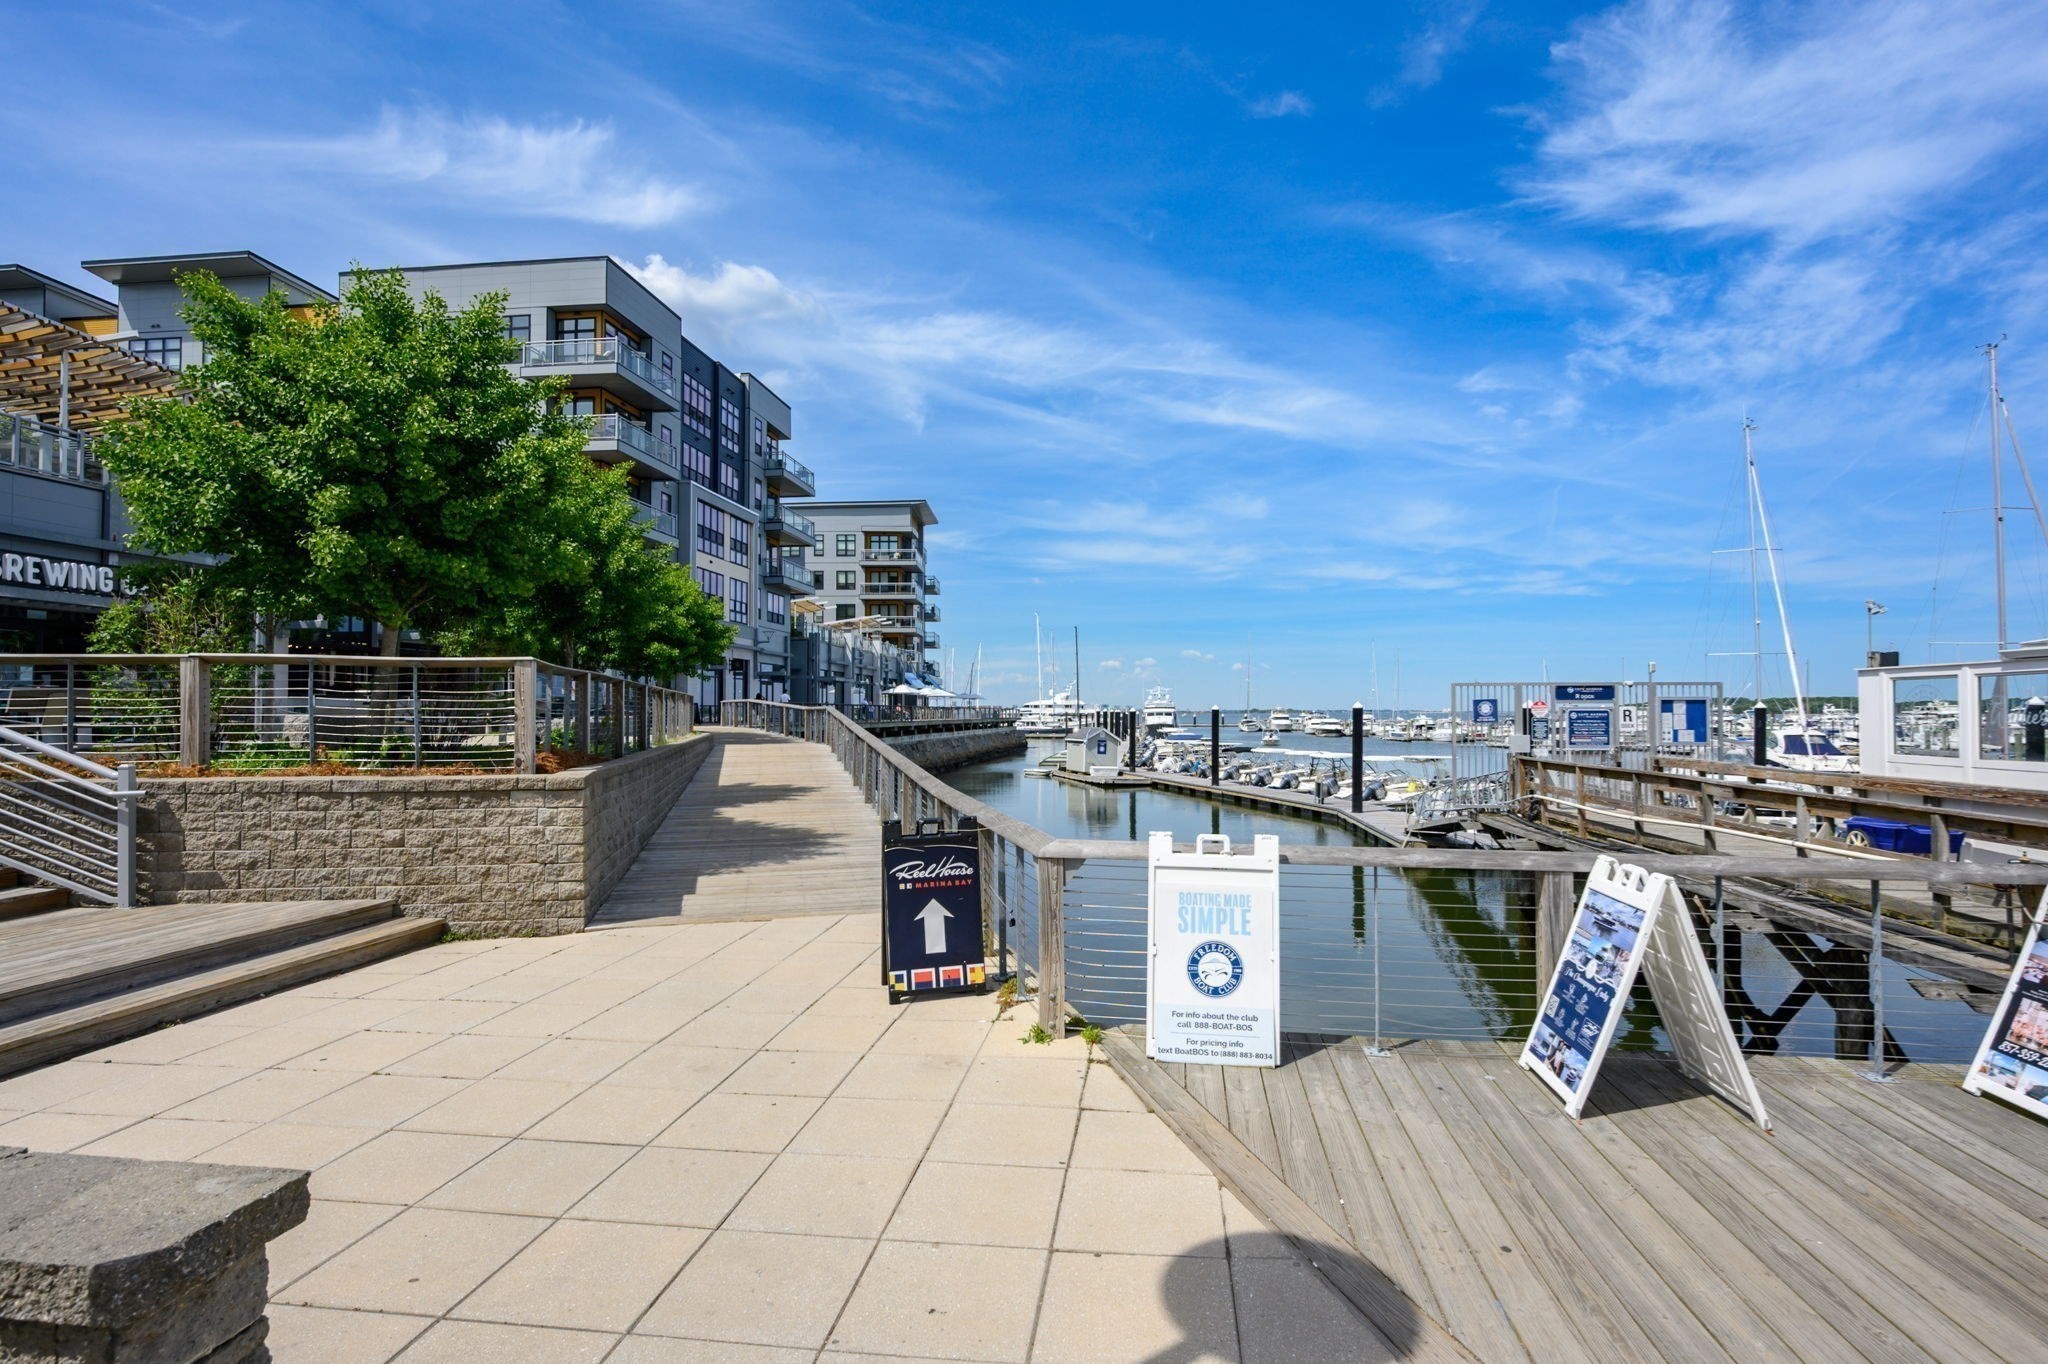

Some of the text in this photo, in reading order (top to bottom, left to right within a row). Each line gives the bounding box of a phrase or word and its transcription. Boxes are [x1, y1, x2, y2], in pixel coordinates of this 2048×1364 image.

[0, 553, 114, 593] REWING
[1623, 709, 1632, 722] R
[915, 878, 973, 889] MARINA BAY
[1178, 892, 1252, 908] BOATING MADE
[1178, 906, 1252, 936] SIMPLE
[1193, 943, 1237, 962] FREEDOM
[1194, 977, 1237, 995] BOAT CLUB
[1171, 1010, 1259, 1022] For info about the club
[1177, 1021, 1253, 1032] call 888-BOAT-BOS
[1186, 1038, 1244, 1048] For pricing info
[1158, 1047, 1173, 1055] text
[1174, 1047, 1209, 1056] BoatBOS
[1211, 1049, 1219, 1057] to
[1220, 1050, 1239, 1058] (888)
